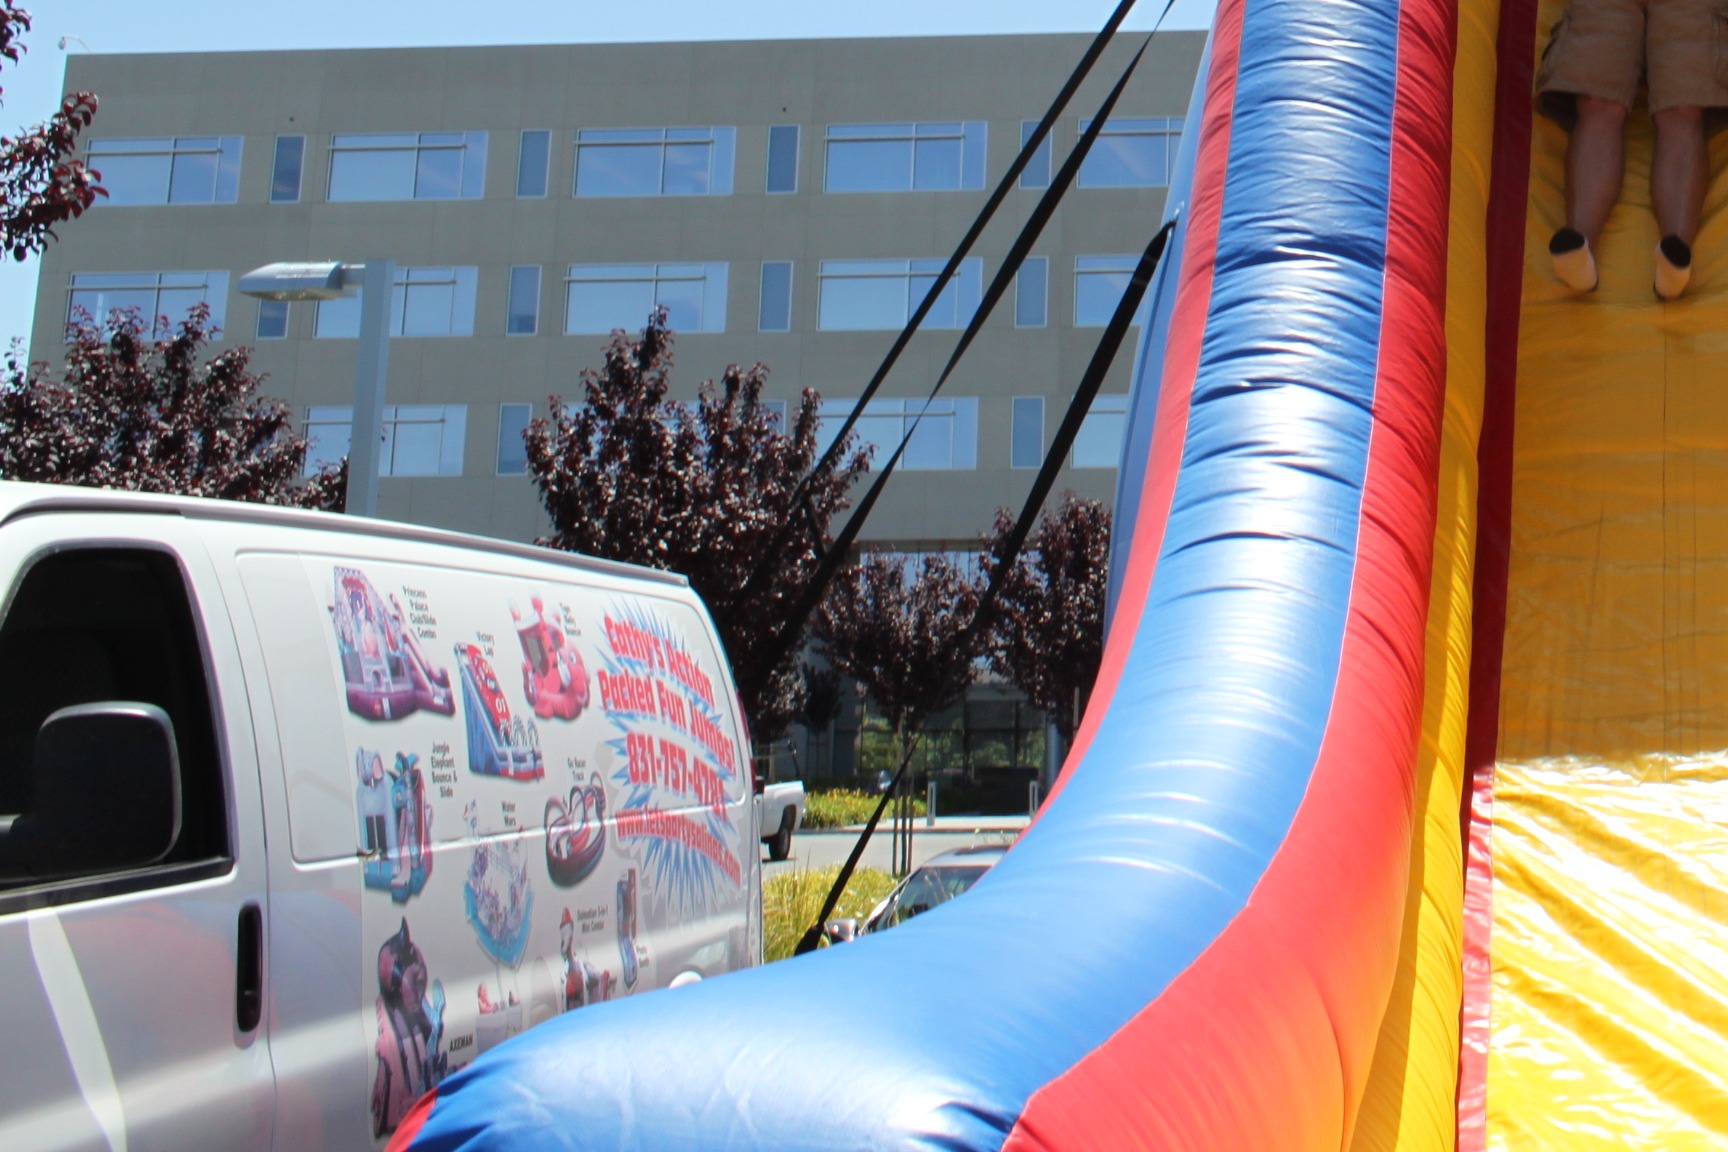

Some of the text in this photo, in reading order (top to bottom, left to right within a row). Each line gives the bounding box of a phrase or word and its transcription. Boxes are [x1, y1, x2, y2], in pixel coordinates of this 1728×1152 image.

[604, 614, 715, 709] Cathy's Action
[597, 668, 737, 779] Packed Fun Jumps!
[449, 1033, 474, 1052] AXEMAN
